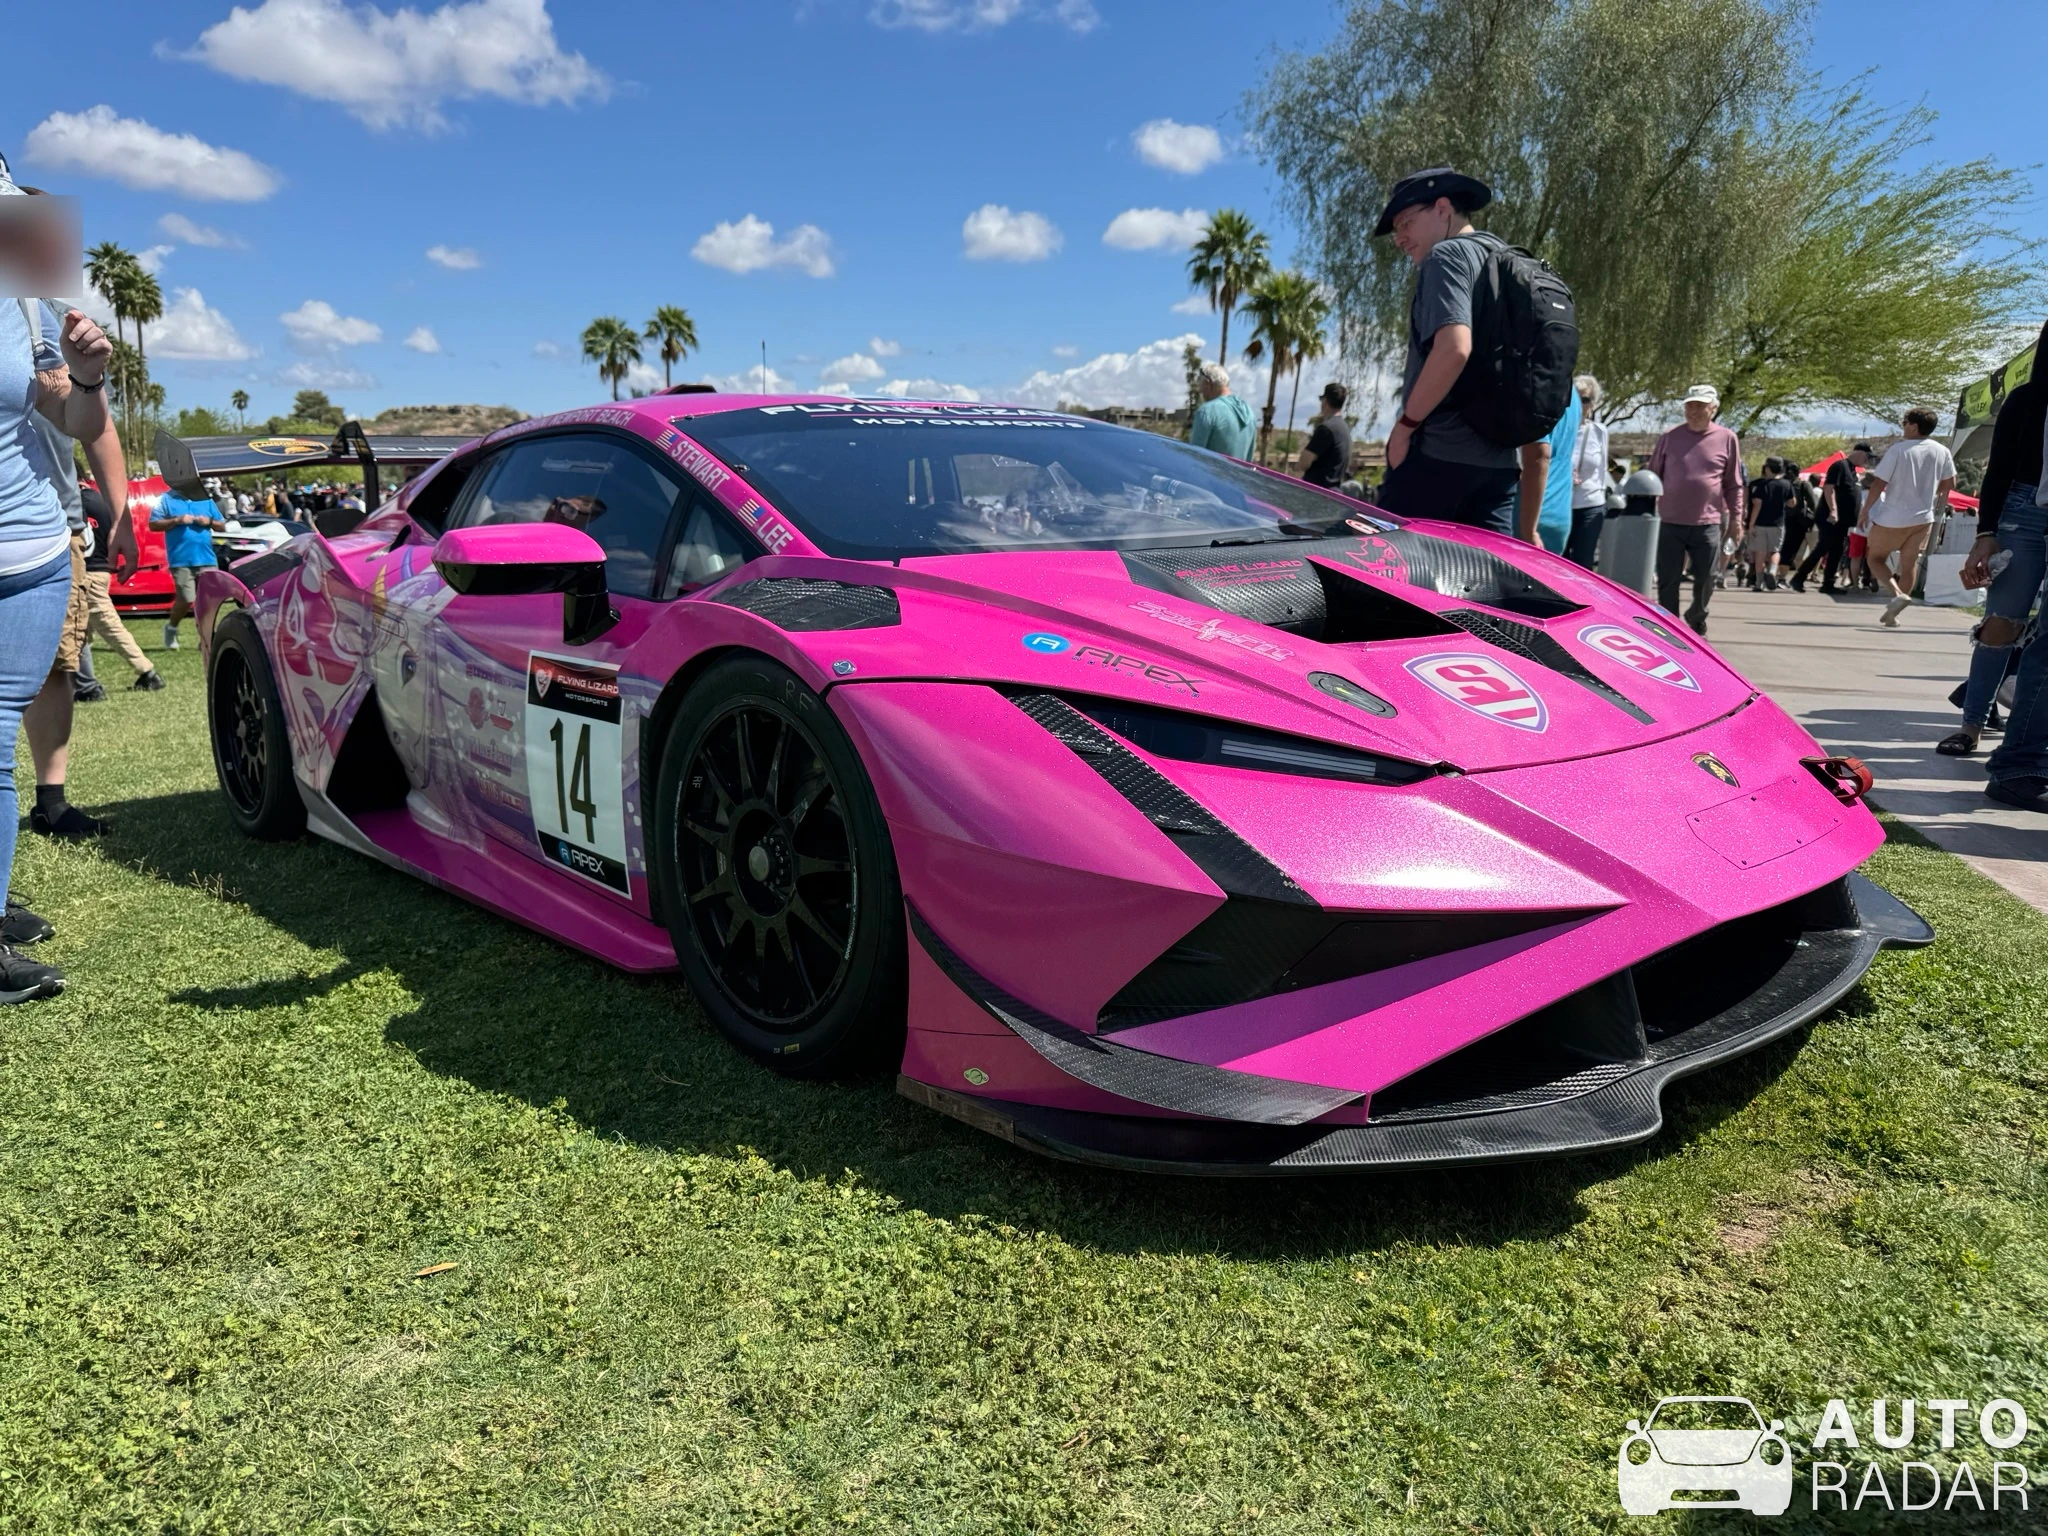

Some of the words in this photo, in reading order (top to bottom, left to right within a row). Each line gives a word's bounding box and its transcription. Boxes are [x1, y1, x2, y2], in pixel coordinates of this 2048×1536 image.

[550, 408, 602, 425] NEWPORT
[596, 409, 635, 426] BEACH
[759, 404, 942, 415] FLYING
[852, 418, 1085, 428] MOTORSPORTS
[671, 441, 730, 491] STEWART
[756, 517, 794, 555] LEE
[1176, 564, 1240, 578] FLYING
[1241, 560, 1303, 571] LIZARD
[1075, 646, 1206, 693] APEX
[557, 675, 587, 688] FLYING
[588, 680, 619, 694] LIZARD
[565, 693, 608, 706] MOTORSPORTS
[550, 717, 597, 844] 14
[571, 849, 605, 876] APEX
